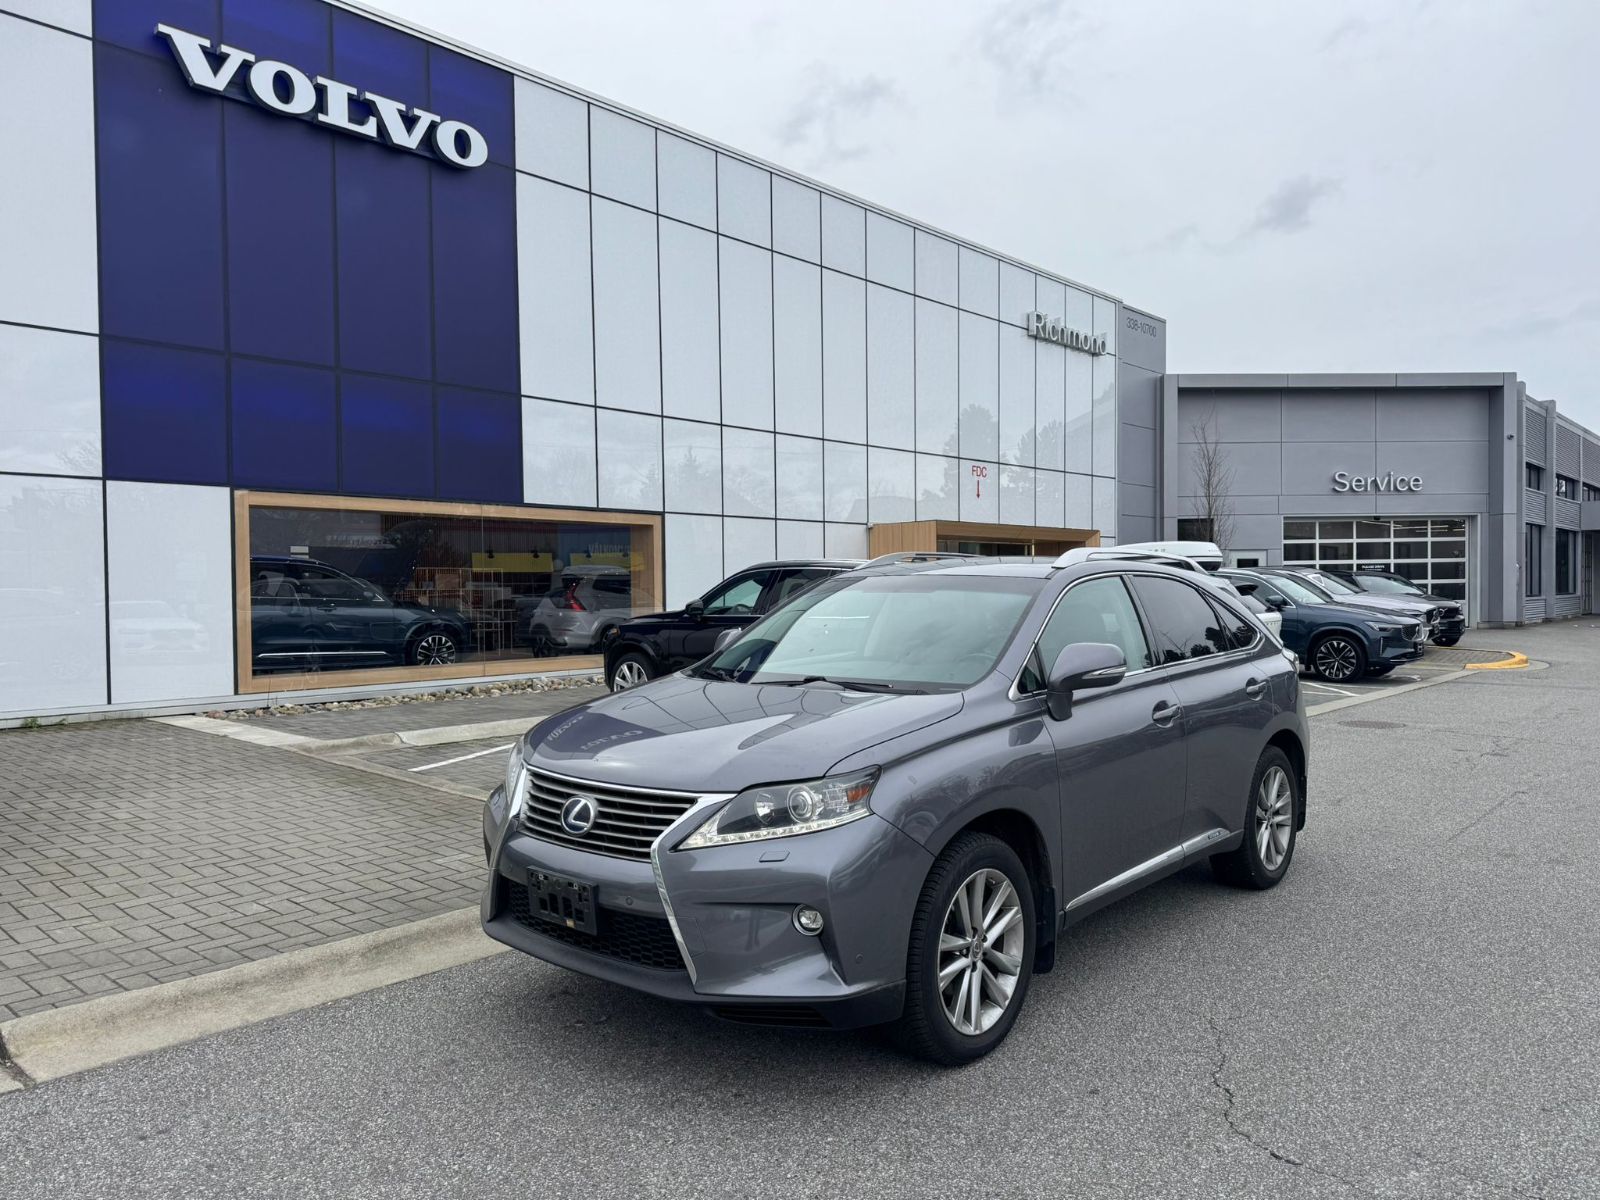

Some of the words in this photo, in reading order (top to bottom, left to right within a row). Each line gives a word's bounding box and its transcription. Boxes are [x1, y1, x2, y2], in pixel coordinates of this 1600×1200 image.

[154, 23, 489, 169] VOLVO
[1028, 311, 1107, 355] Richmond
[971, 465, 987, 478] FDC
[1333, 471, 1423, 492] Service
